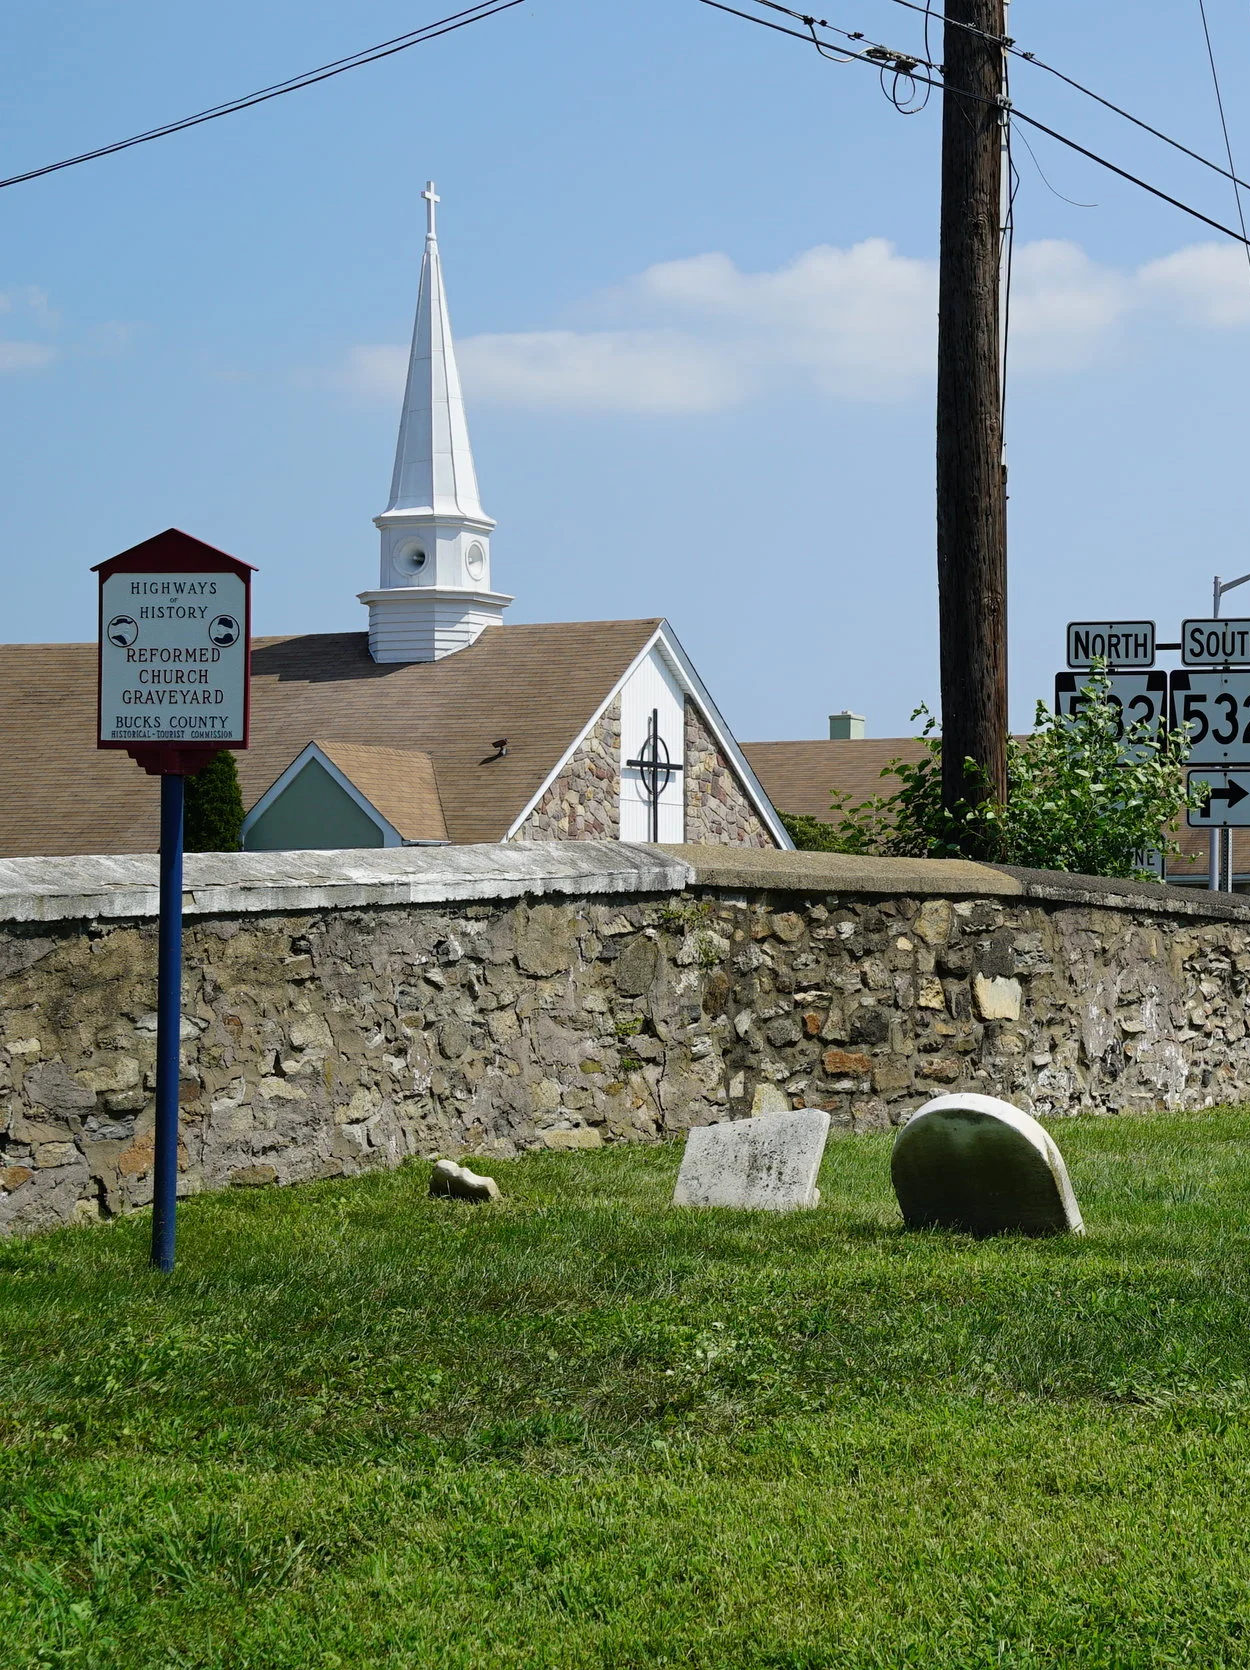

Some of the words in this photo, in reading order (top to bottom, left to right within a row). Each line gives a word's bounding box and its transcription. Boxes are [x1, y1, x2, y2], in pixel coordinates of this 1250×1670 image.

[130, 582, 217, 594] HIGHWAYS
[140, 606, 208, 618] HISTORY
[1074, 630, 1148, 660] NORTH
[126, 648, 220, 662] REFORMED
[139, 670, 209, 684] CHURCH
[122, 690, 224, 705] GRAVEYARD
[116, 716, 160, 728] BUCKS
[169, 716, 229, 728] COUNTY
[191, 730, 232, 739] COMMISSION
